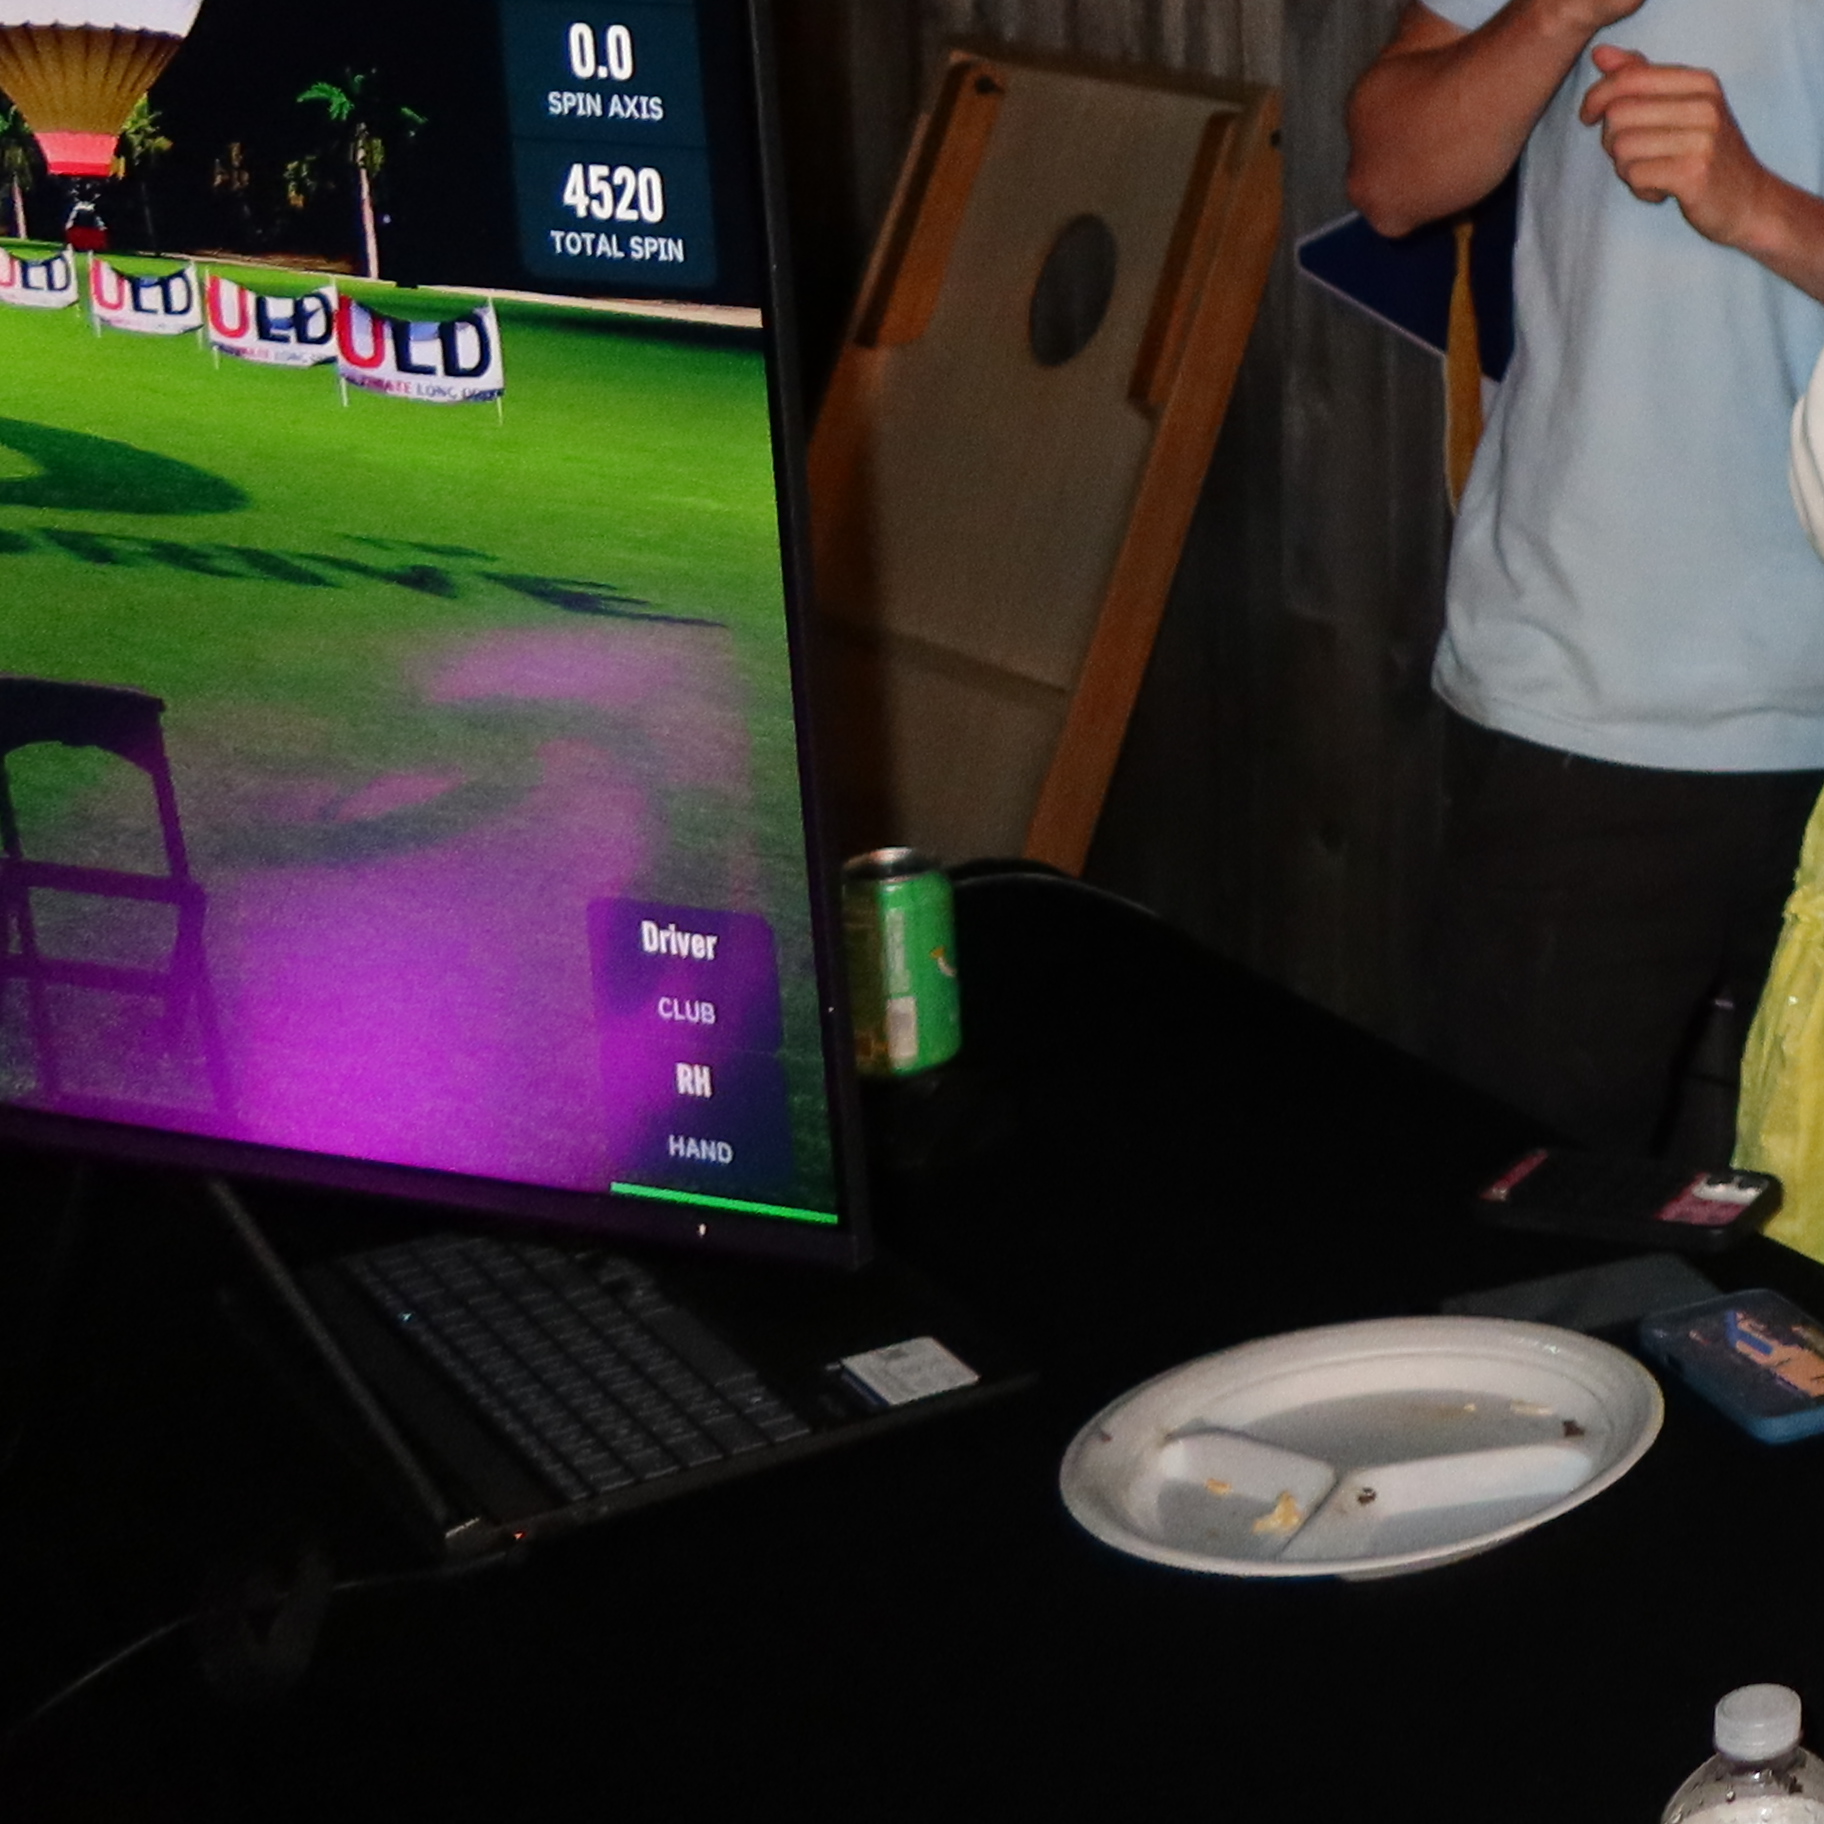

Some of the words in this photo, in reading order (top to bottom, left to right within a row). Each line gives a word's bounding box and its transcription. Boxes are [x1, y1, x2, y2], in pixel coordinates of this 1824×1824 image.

[568, 22, 632, 82] 0.0
[548, 91, 602, 118] SPIN
[608, 94, 663, 121] AXIS
[562, 163, 664, 224] 4520
[550, 230, 625, 259] TOTAL
[630, 234, 684, 263] SPIN
[89, 258, 193, 315] ULD
[206, 274, 334, 345] ULD
[335, 293, 492, 377] ULD
[641, 919, 718, 960] Driver
[658, 997, 716, 1025] CLUB
[676, 1062, 712, 1098] RH
[668, 1135, 733, 1164] HAND
